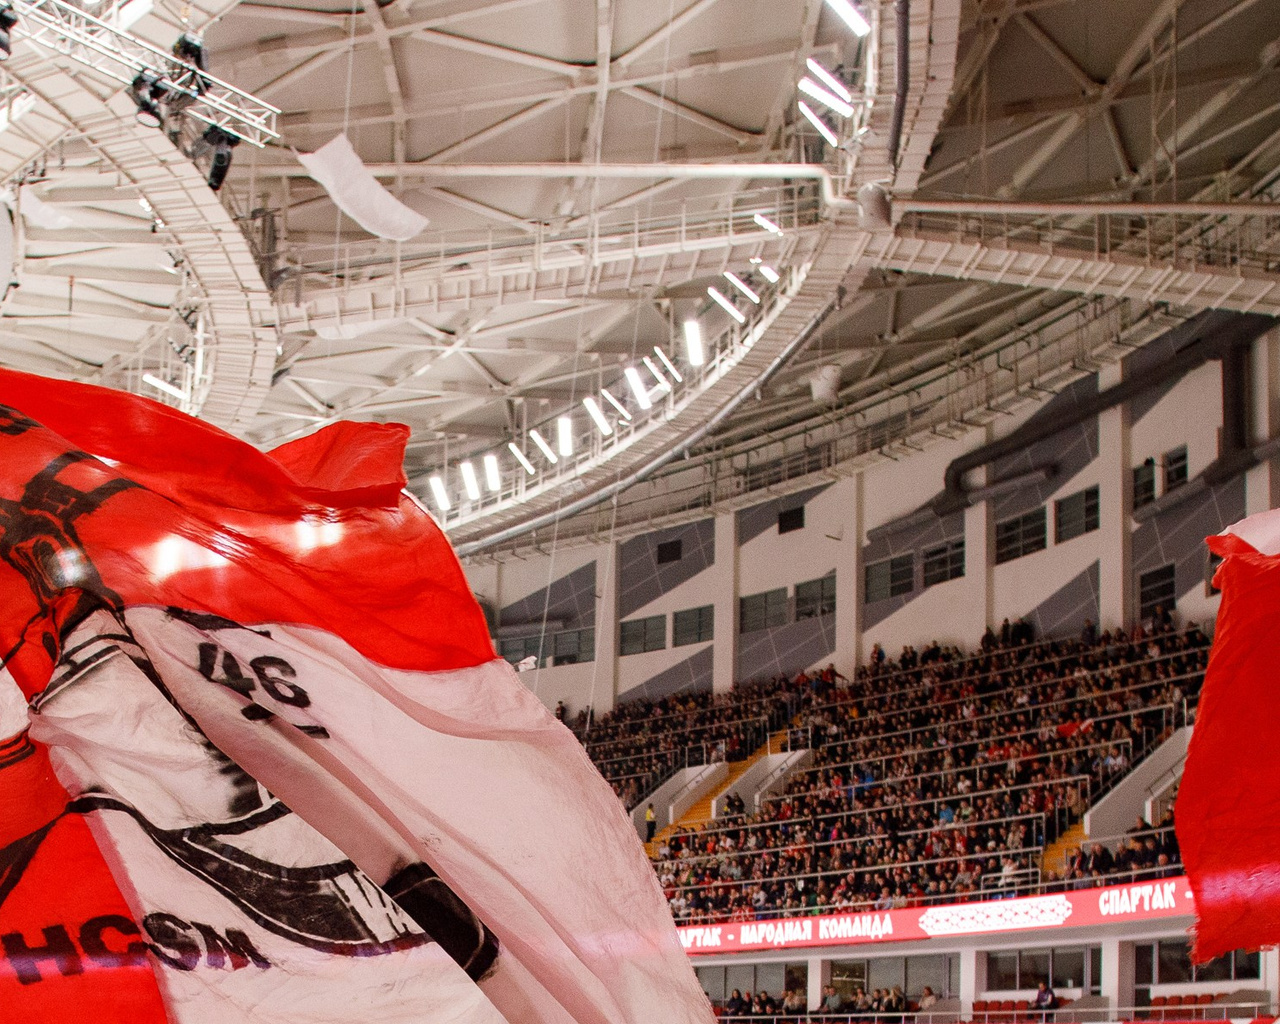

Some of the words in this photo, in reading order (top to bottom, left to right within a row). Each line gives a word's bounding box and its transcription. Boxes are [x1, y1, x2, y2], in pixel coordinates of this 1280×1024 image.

[197, 641, 312, 709] 46
[1098, 881, 1177, 916] СПАРТАК
[678, 926, 723, 949] АРТАК
[740, 919, 813, 946] НАРОДНАЯ
[818, 913, 894, 940] КОМАНДА
